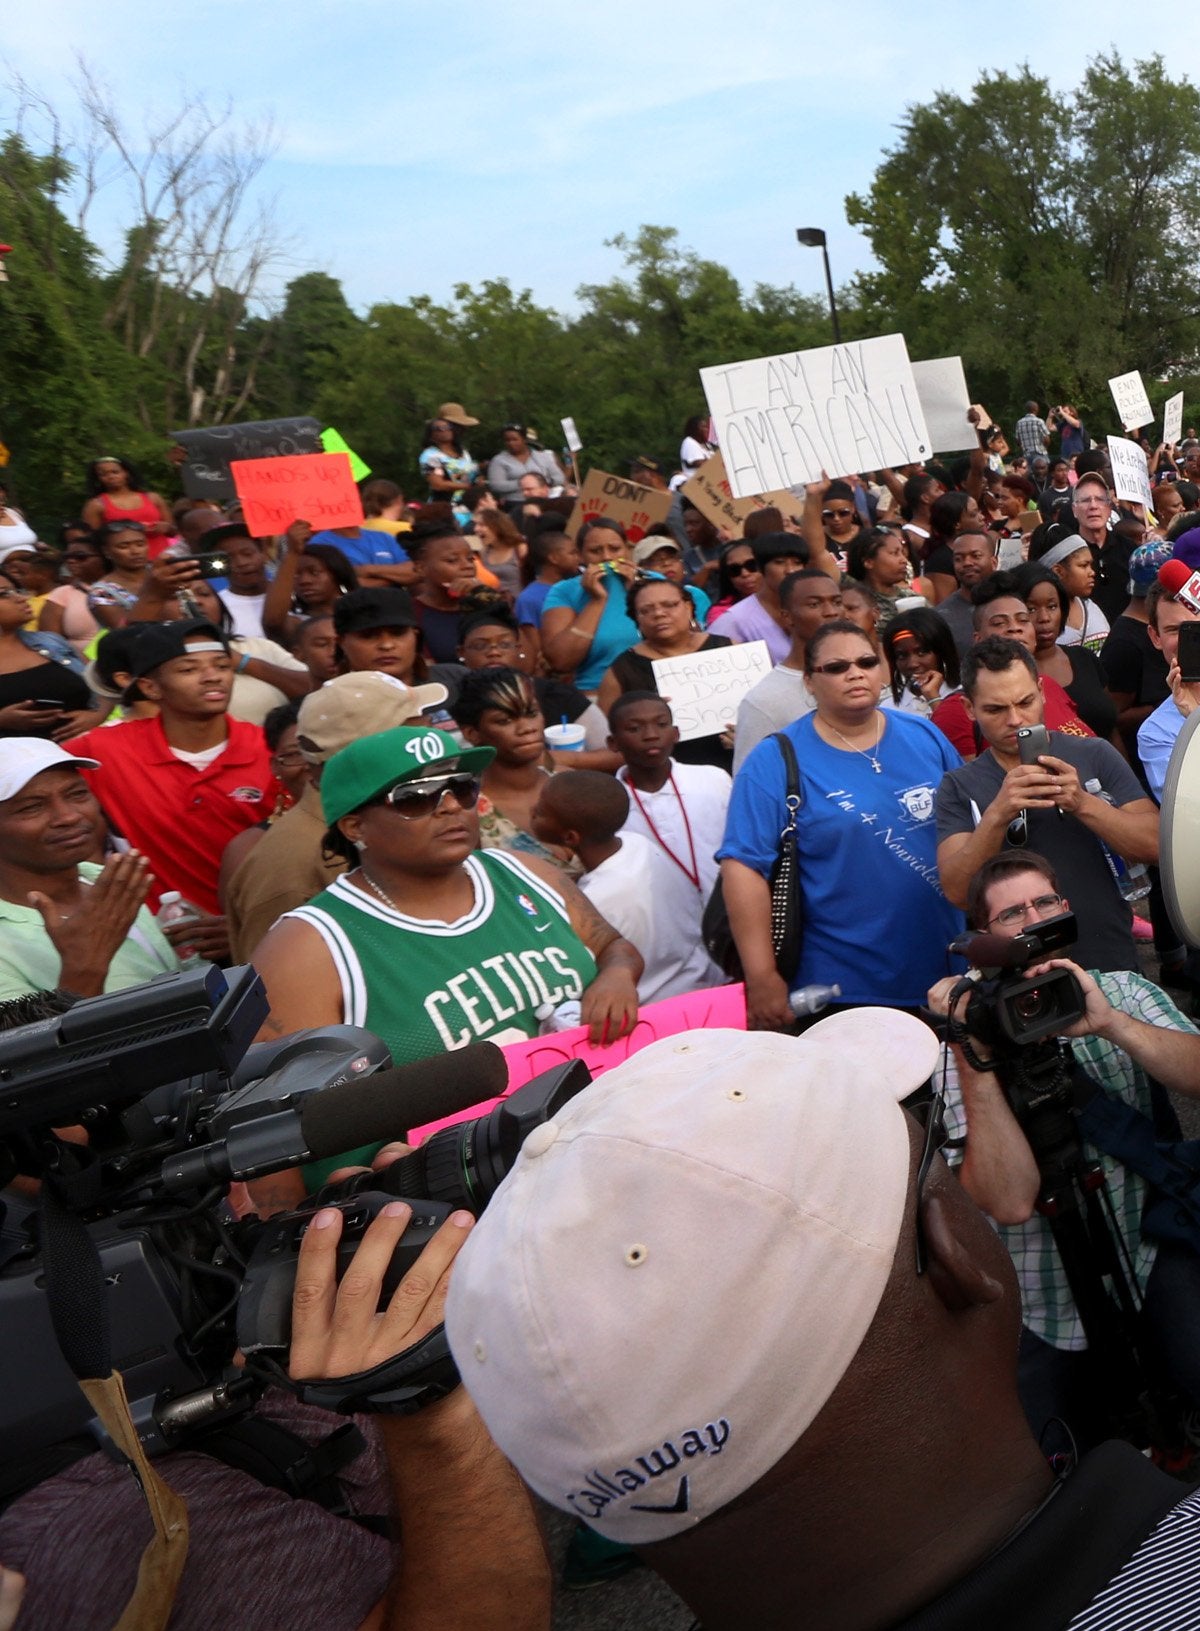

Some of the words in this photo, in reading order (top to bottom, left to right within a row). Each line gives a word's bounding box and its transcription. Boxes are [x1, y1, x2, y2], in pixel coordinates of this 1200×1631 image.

[716, 366, 758, 417] I
[768, 354, 814, 406] AM
[832, 343, 869, 395] AN
[726, 384, 925, 497] AMERICAN!
[1110, 445, 1125, 466] We
[602, 477, 650, 503] DONT
[910, 801, 932, 812] BLF
[424, 947, 583, 1051] CELTICS
[566, 1418, 731, 1519] Callaway
